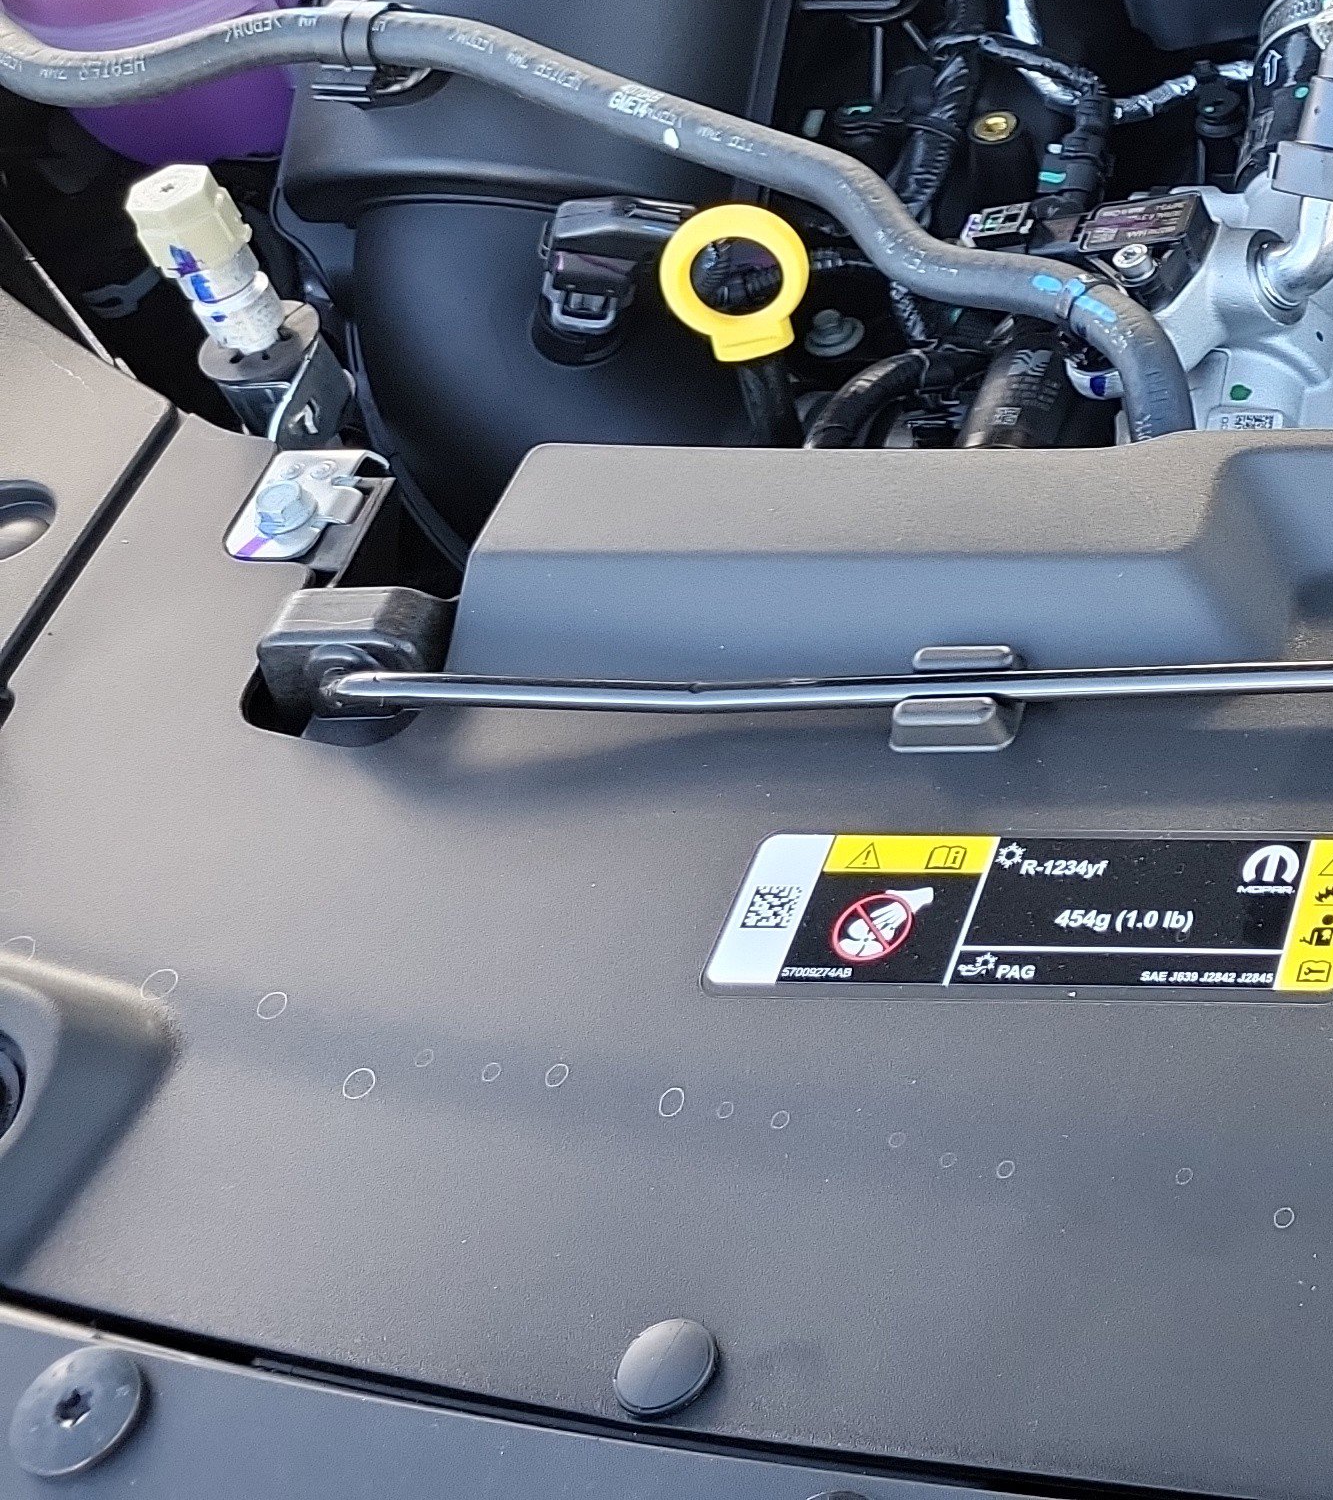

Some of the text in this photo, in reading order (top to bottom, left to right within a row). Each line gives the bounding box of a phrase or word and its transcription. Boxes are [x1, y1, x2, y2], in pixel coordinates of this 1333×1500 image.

[1019, 859, 1109, 879] R-1234yf
[1236, 885, 1293, 895] MOPAR
[1054, 909, 1195, 933] 454g (1.0 lb)
[781, 967, 853, 979] 57009274AB
[995, 965, 1036, 980] PAG
[1140, 971, 1167, 982] SAE
[1199, 972, 1236, 983] J2842
[1236, 972, 1275, 984] J2845
